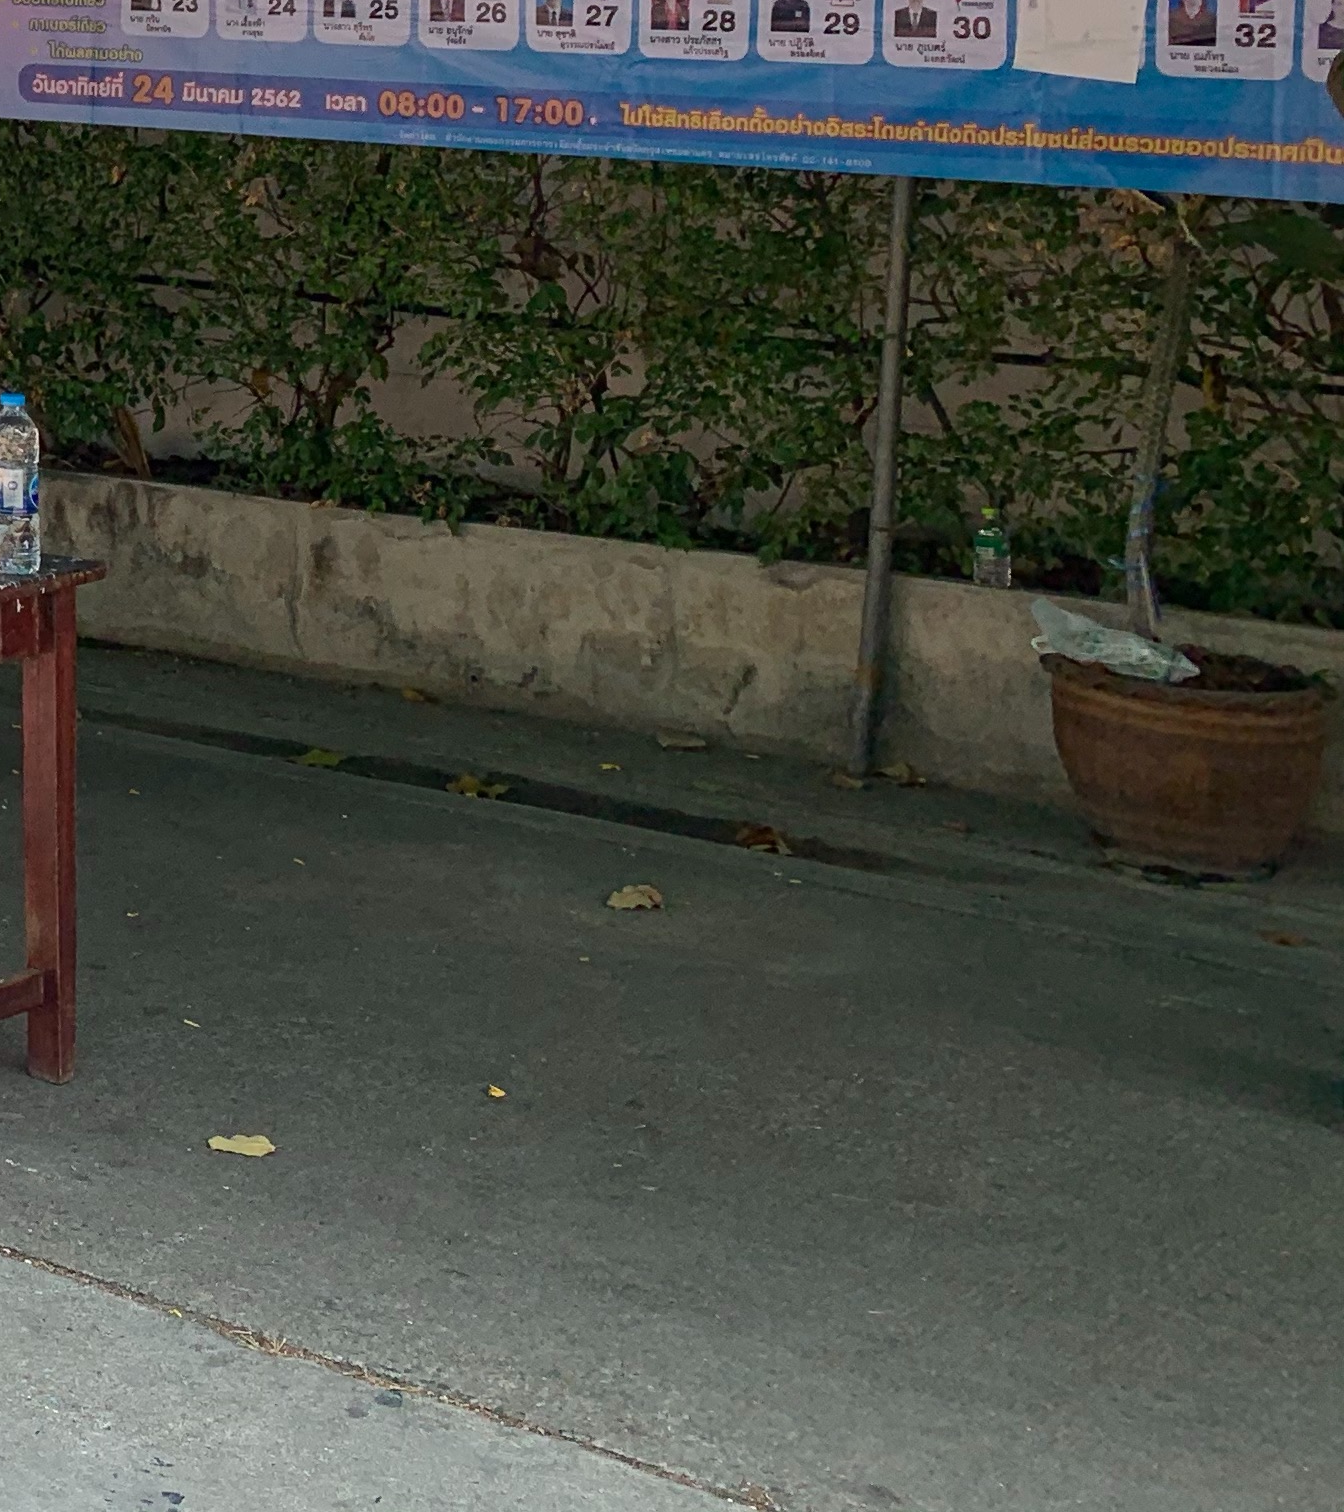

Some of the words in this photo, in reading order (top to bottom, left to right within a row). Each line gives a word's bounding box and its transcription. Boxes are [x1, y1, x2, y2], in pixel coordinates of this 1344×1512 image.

[369, 0, 398, 19] 25
[476, 2, 506, 23] 26
[586, 5, 618, 27] 27
[702, 10, 736, 32] 28
[824, 13, 860, 35] 29
[953, 16, 991, 39] 30
[1234, 23, 1277, 48] 32
[32, 72, 125, 99] วันอาทิตย์ที่
[130, 73, 175, 105] 24
[182, 82, 244, 104] มีนาคม
[251, 87, 301, 109] 2562
[324, 92, 368, 113] เวลา
[377, 88, 465, 121] 08:00
[495, 94, 584, 127] 17:00
